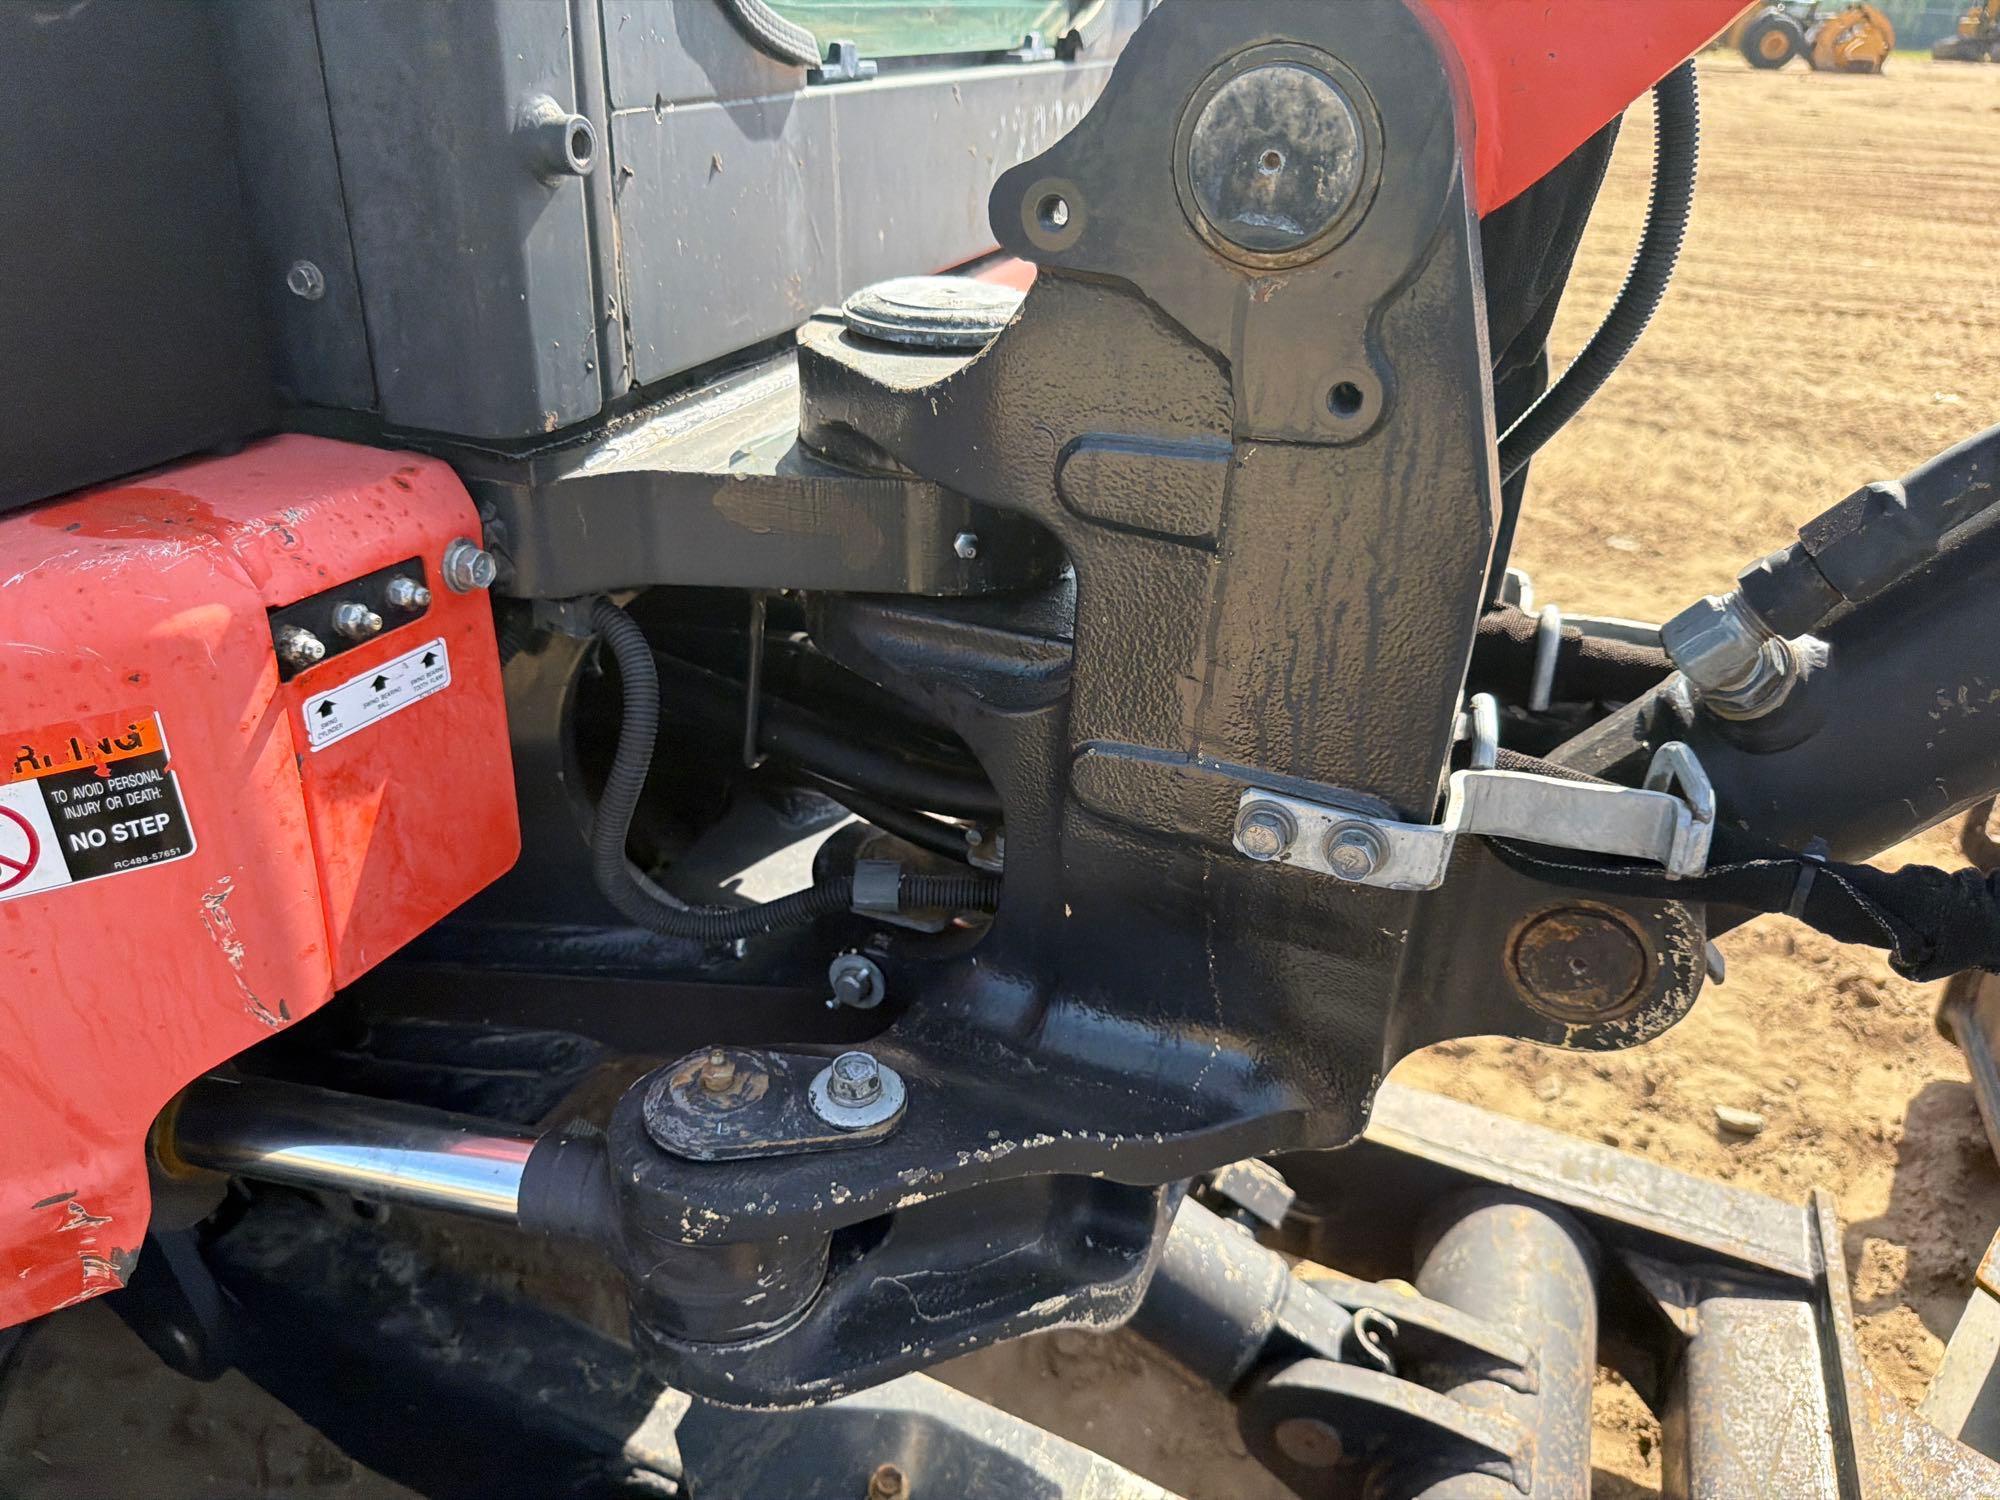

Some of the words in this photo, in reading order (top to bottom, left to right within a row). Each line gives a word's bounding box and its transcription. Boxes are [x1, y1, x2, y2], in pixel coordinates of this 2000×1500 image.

[51, 789, 68, 804] TO
[73, 782, 104, 800] AVOID
[108, 768, 164, 792] PERSONAL
[63, 800, 101, 820] INJURY
[106, 796, 123, 811] OR
[128, 787, 164, 807] DEATH:
[69, 828, 107, 852] NO
[111, 812, 171, 842] STEP
[113, 847, 182, 870] RC488-57651
